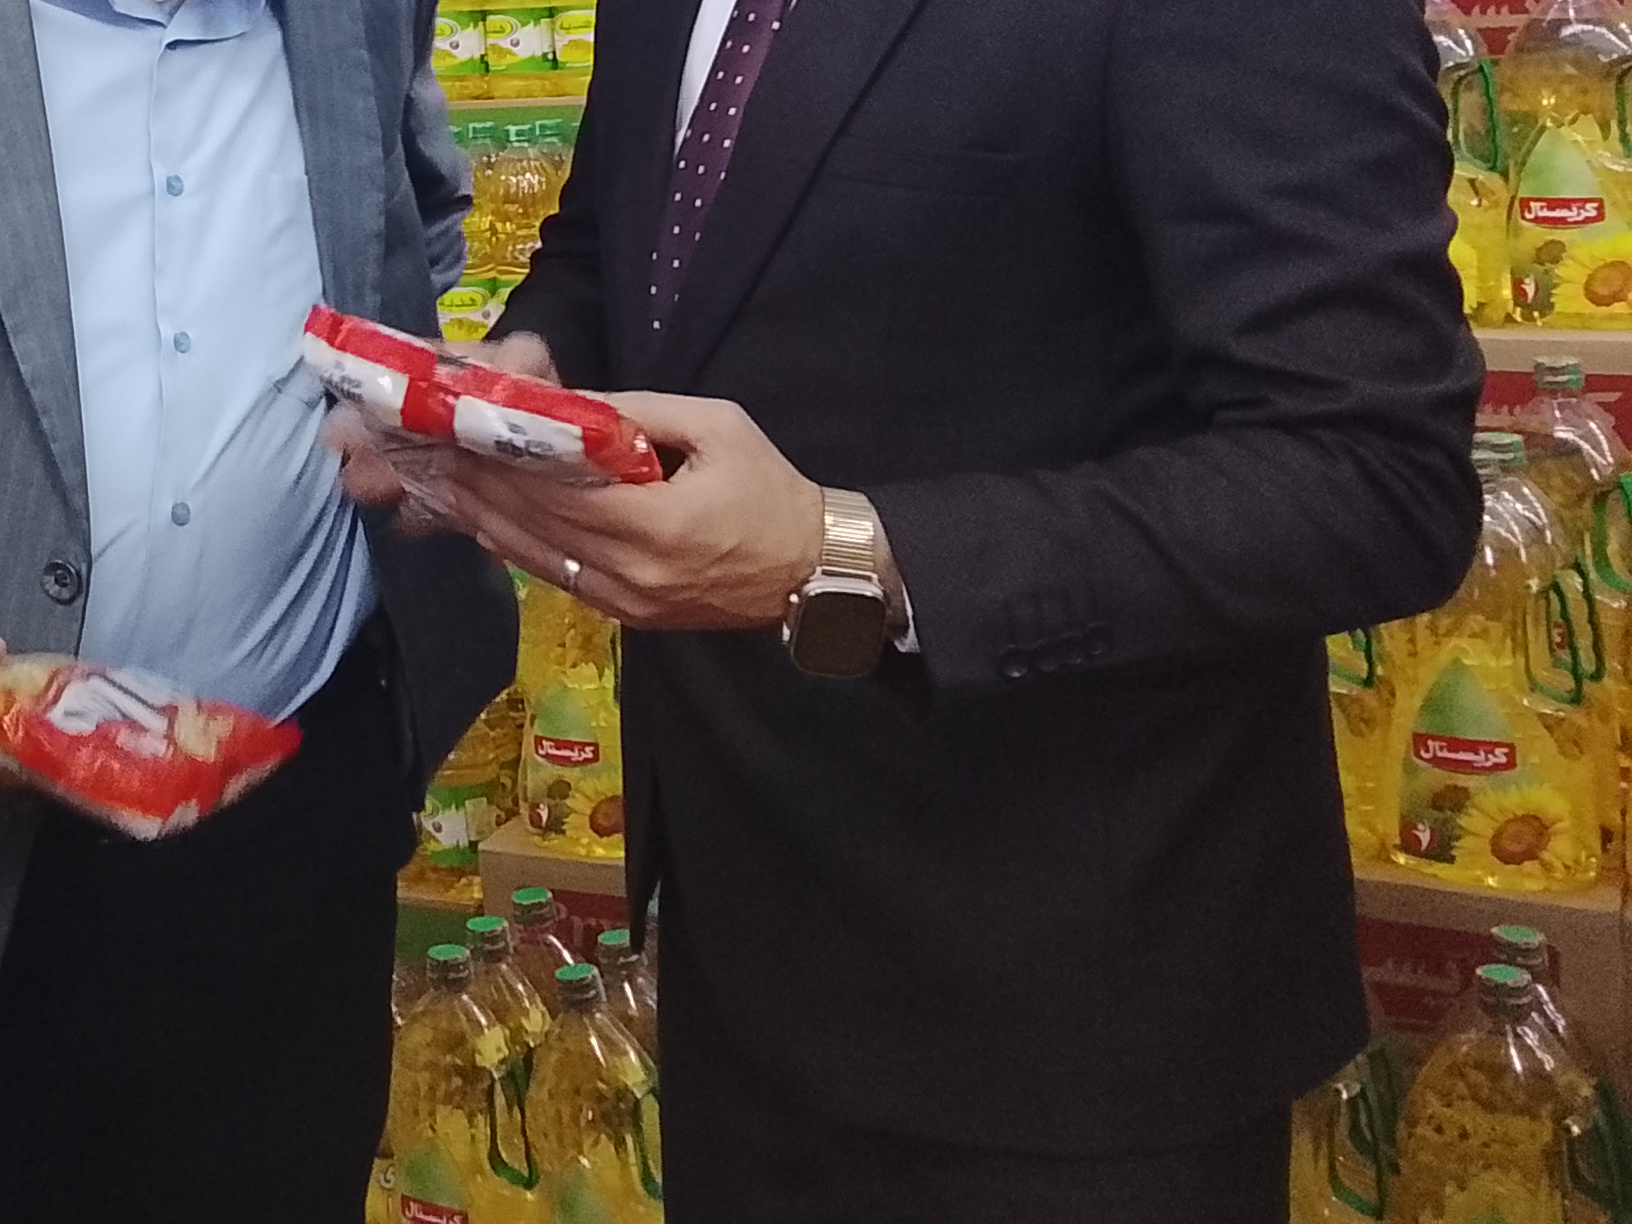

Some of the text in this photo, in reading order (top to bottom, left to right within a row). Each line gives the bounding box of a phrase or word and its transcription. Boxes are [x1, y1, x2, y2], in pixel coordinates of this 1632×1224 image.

[1524, 201, 1600, 222] كريستال
[537, 738, 595, 762] كريستال
[1420, 739, 1510, 768] كريستال
